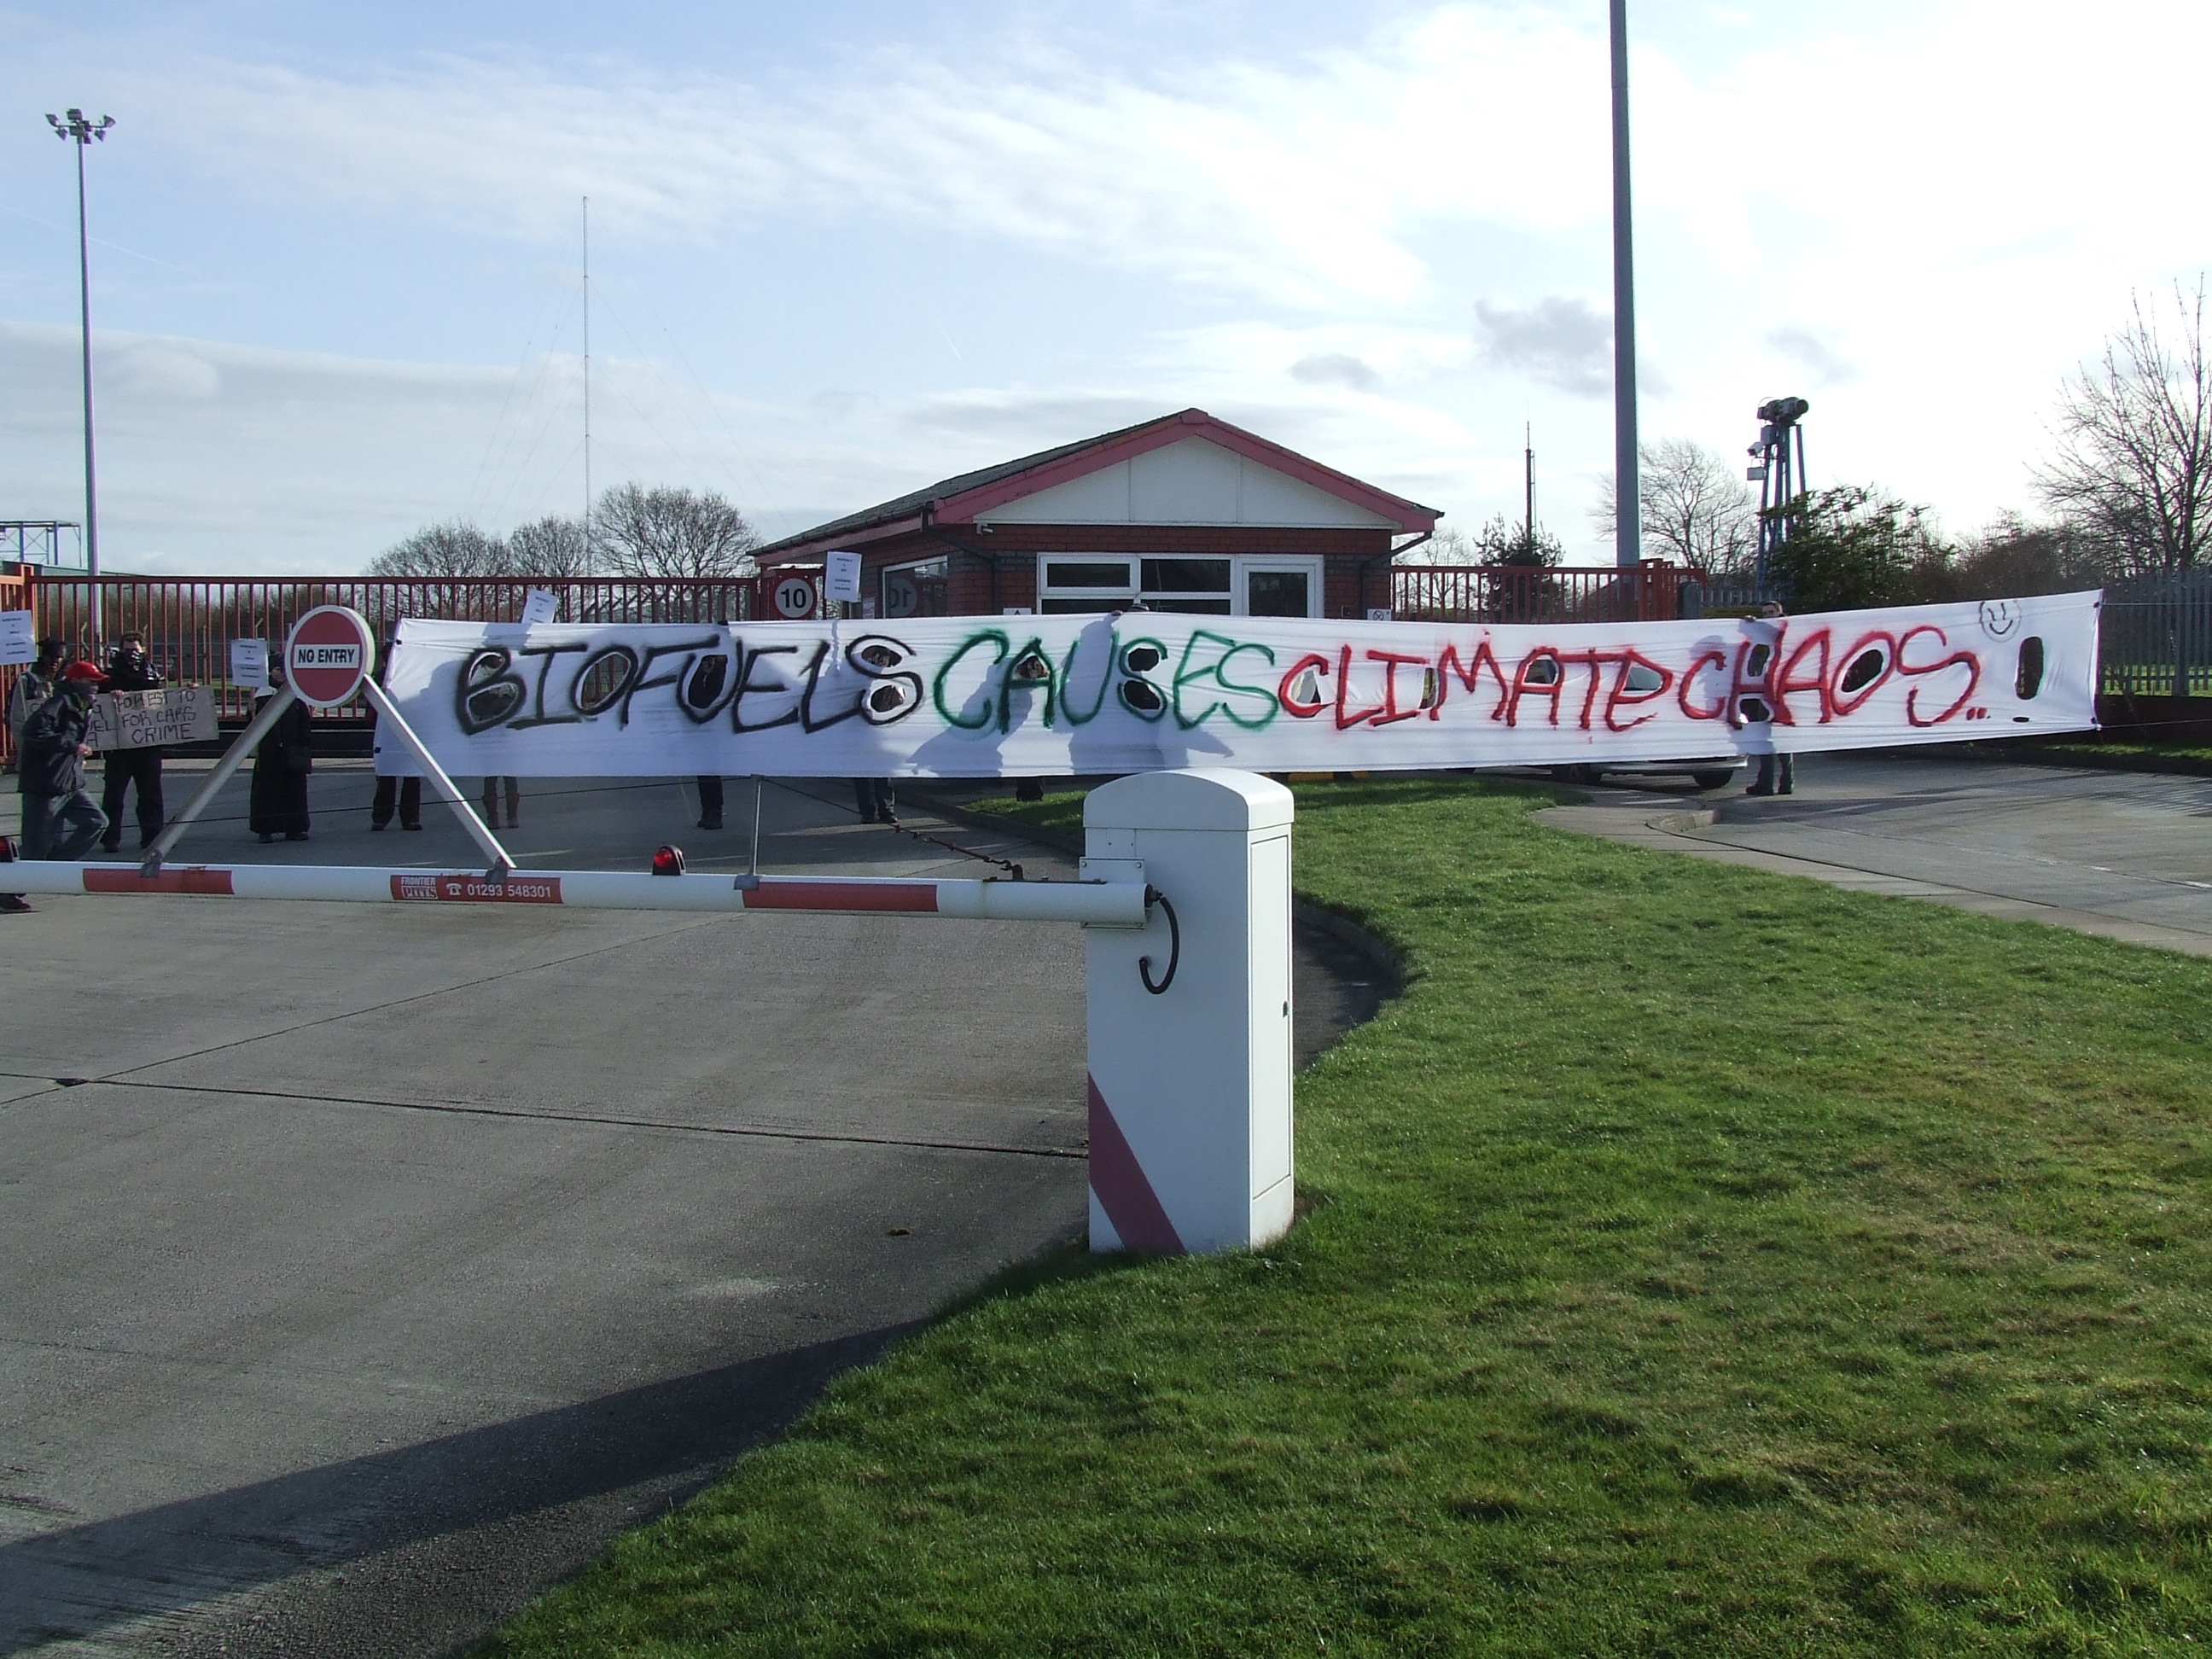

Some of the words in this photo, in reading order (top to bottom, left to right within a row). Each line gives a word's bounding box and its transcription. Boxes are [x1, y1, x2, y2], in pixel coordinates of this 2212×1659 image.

[781, 588, 806, 608] 10
[298, 649, 315, 663] NO
[317, 649, 355, 663] ENTRY
[456, 634, 923, 735] BIOFUELS
[933, 628, 1280, 735] CAUSES
[1279, 631, 1674, 732] CLIMATE
[178, 688, 195, 703] TO
[122, 710, 152, 728] FOR
[156, 706, 196, 723] CARS
[131, 723, 195, 744] CRIME
[401, 876, 436, 885] FRONTIER
[467, 883, 504, 896] 01293
[508, 885, 551, 898] 548301
